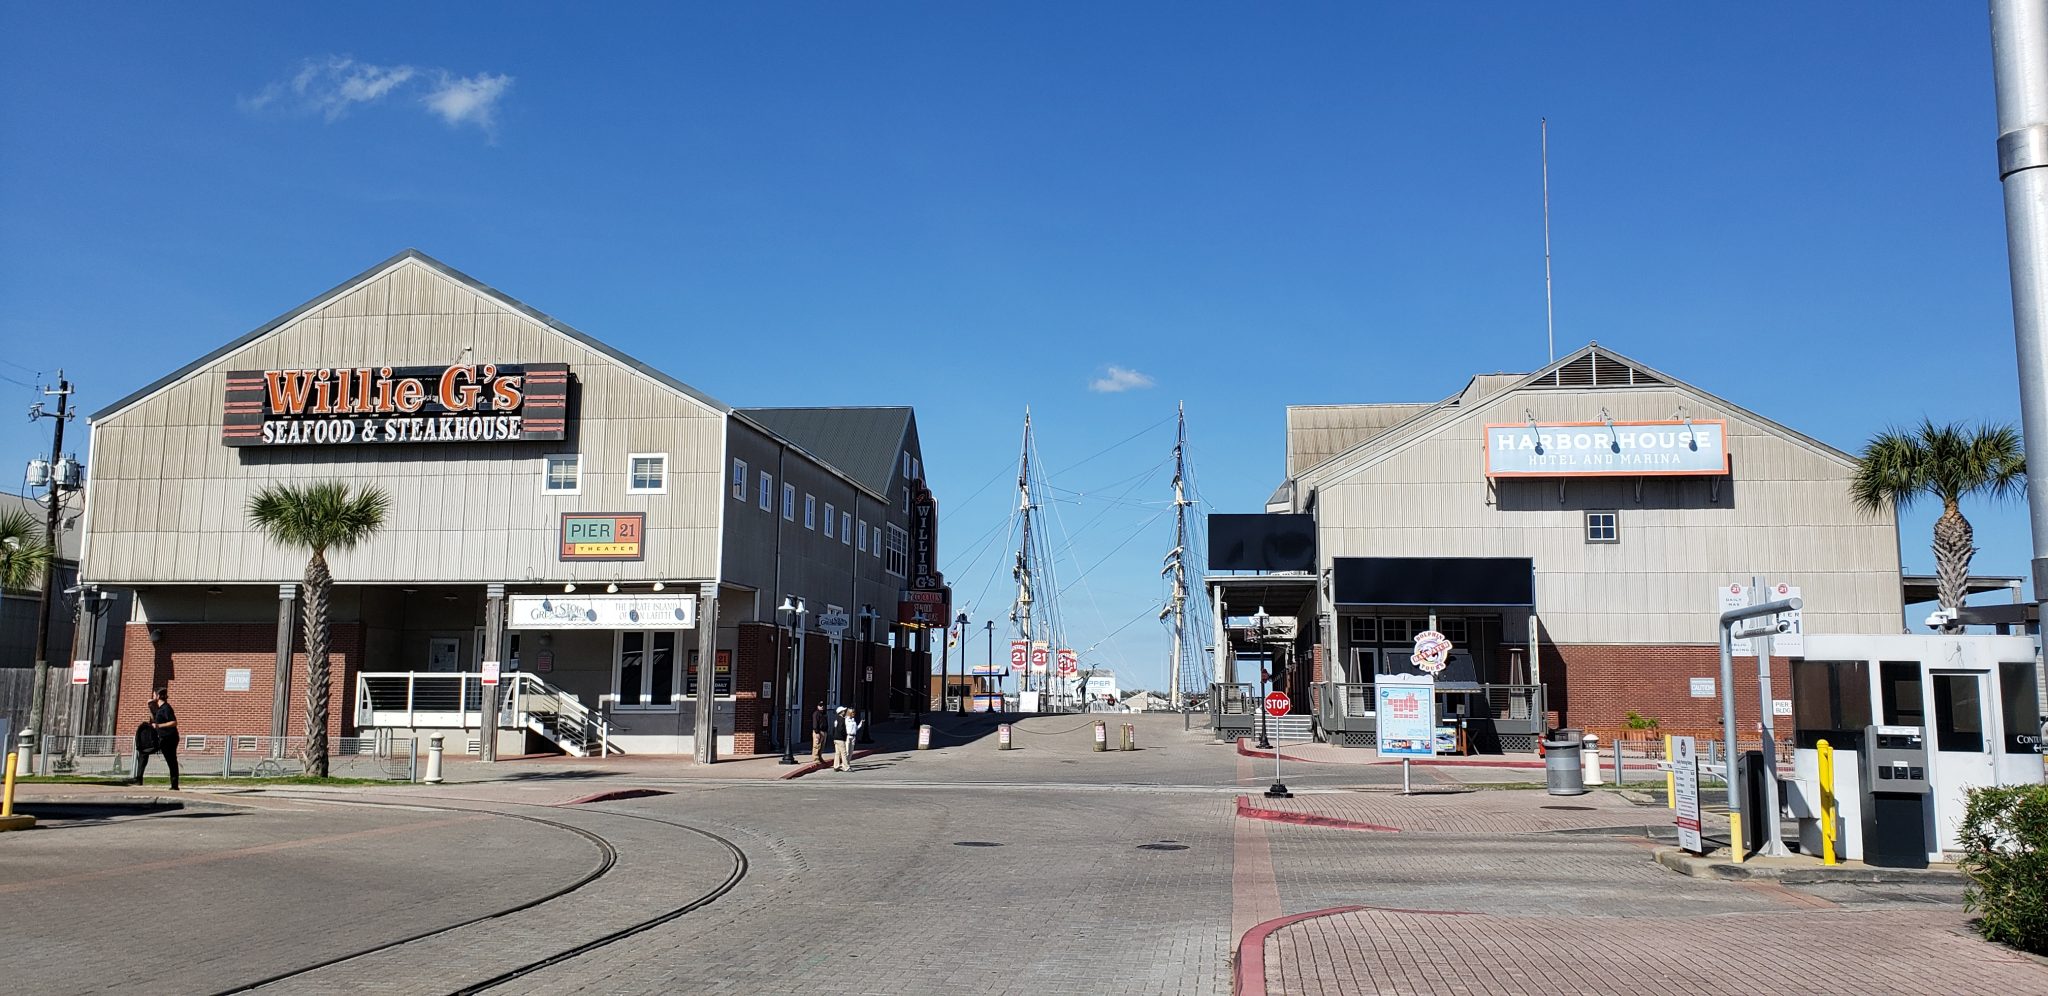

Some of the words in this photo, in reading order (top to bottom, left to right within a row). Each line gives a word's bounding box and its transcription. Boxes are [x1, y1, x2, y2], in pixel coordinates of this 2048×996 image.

[264, 366, 425, 415] Willie
[438, 363, 522, 412] G's
[262, 419, 352, 444] SEAFOOD
[361, 420, 378, 442] &
[384, 416, 522, 442] STEAKHOUSE
[1496, 433, 1608, 450] HARBOR
[1623, 431, 1710, 449] HOUSE
[1529, 454, 1577, 465] HOTEL
[1584, 454, 1611, 465] AND
[1620, 453, 1681, 464] MARINA
[571, 523, 610, 538] PIER
[619, 523, 635, 537] 21
[916, 505, 930, 575] WILLIE
[1012, 652, 1025, 660] 21
[1032, 652, 1047, 660] 21
[1266, 699, 1289, 709] STOP
